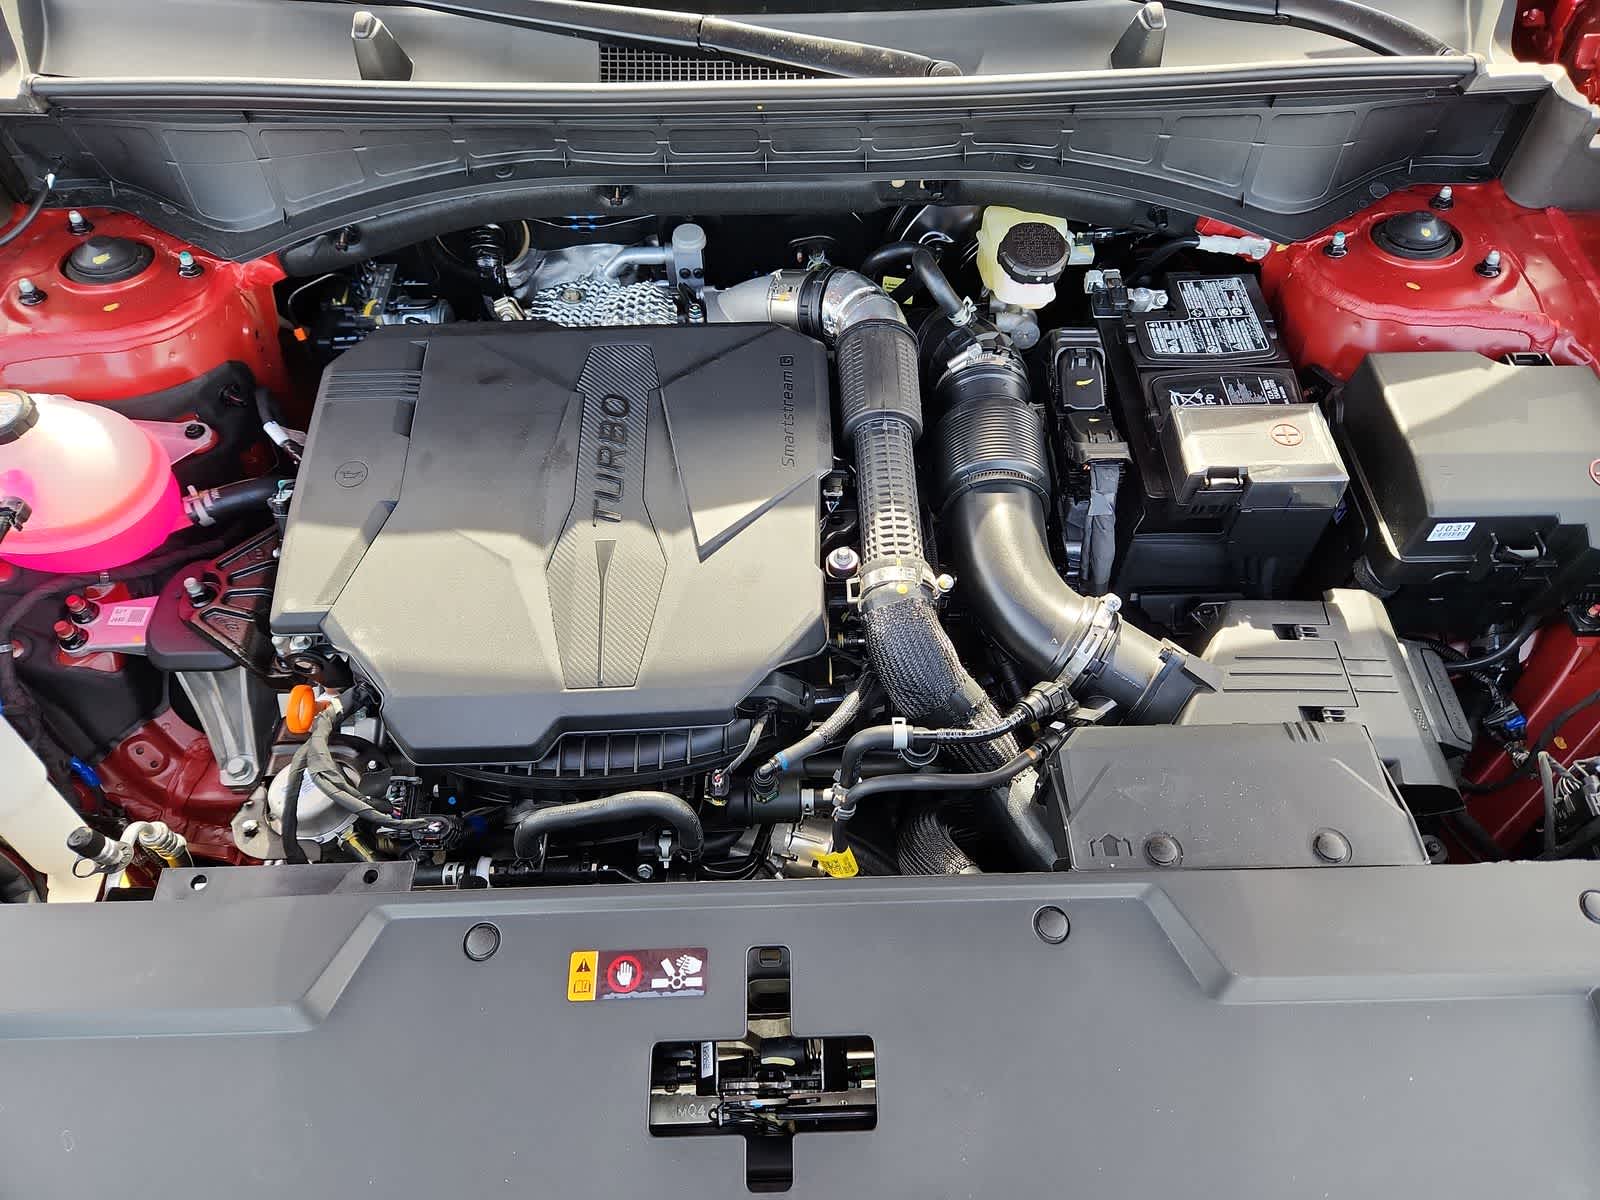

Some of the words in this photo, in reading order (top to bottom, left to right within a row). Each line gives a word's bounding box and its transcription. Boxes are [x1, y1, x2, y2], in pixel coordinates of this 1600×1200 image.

[780, 369, 796, 469] Smartstream
[1204, 393, 1217, 405] Pb
[592, 392, 630, 528] TURBO
